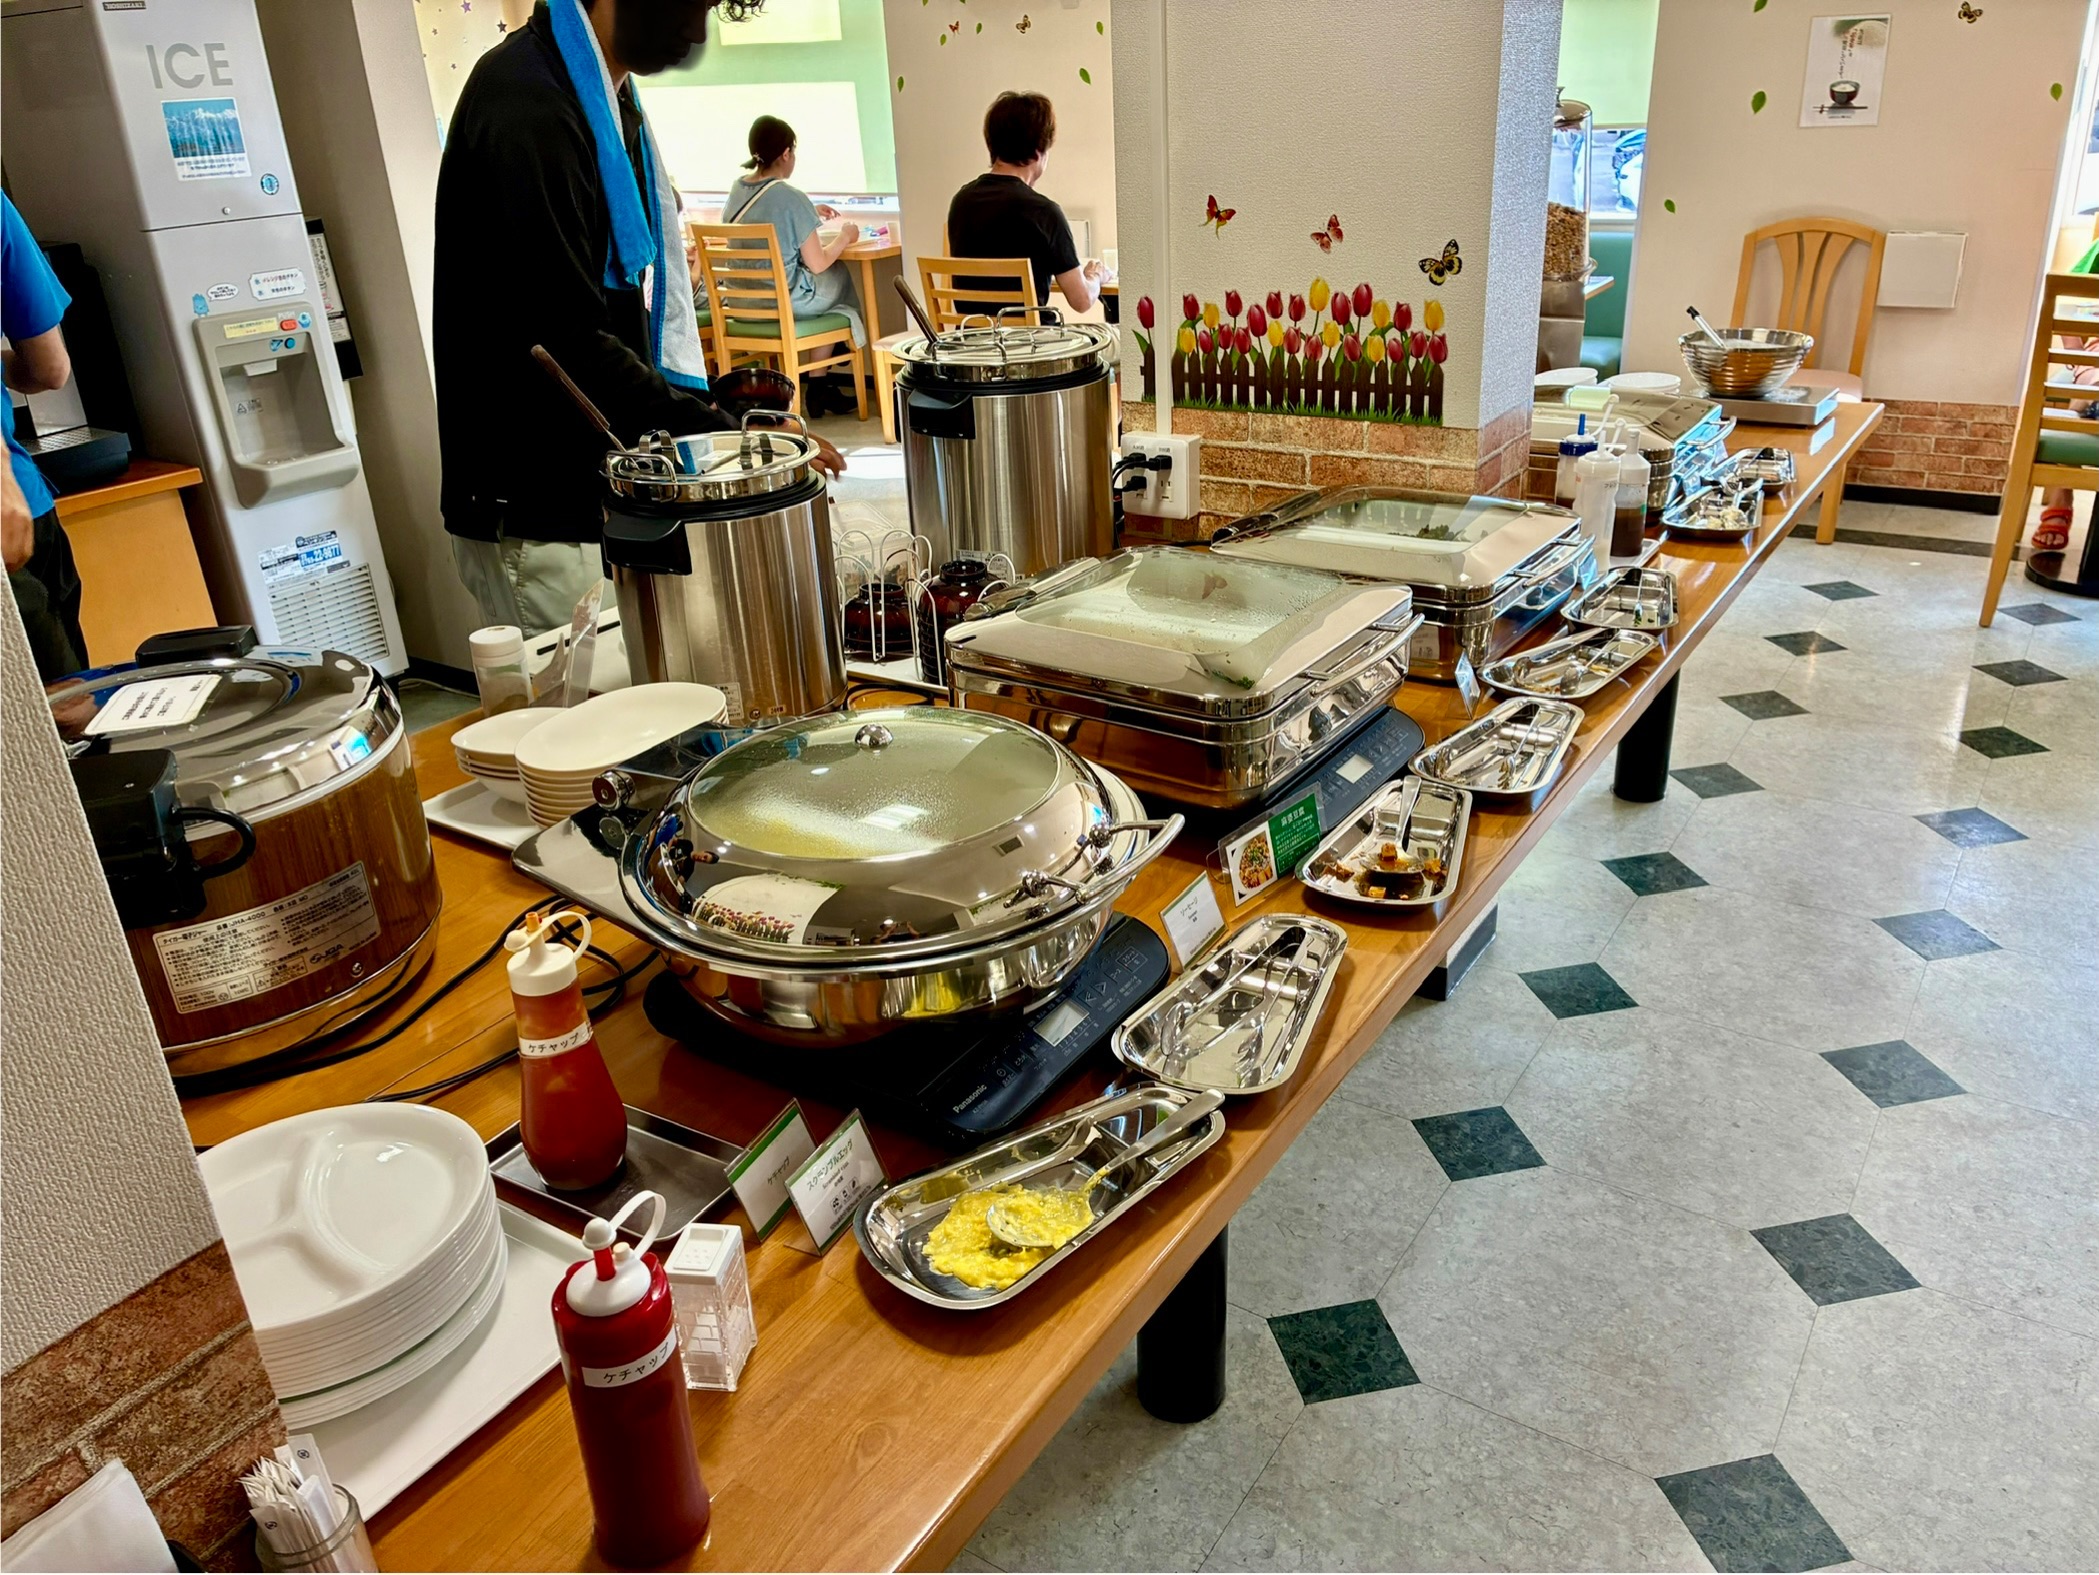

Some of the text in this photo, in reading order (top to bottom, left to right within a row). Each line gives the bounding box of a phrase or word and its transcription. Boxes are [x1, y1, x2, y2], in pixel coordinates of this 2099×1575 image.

[145, 42, 233, 89] ICE
[528, 1032, 579, 1053] ケチャップ
[952, 1084, 988, 1114] Panasonic
[767, 1155, 790, 1185] ケチャップ
[806, 1138, 853, 1191] スクランブルエッグ
[603, 1342, 670, 1384] ケチャップ
